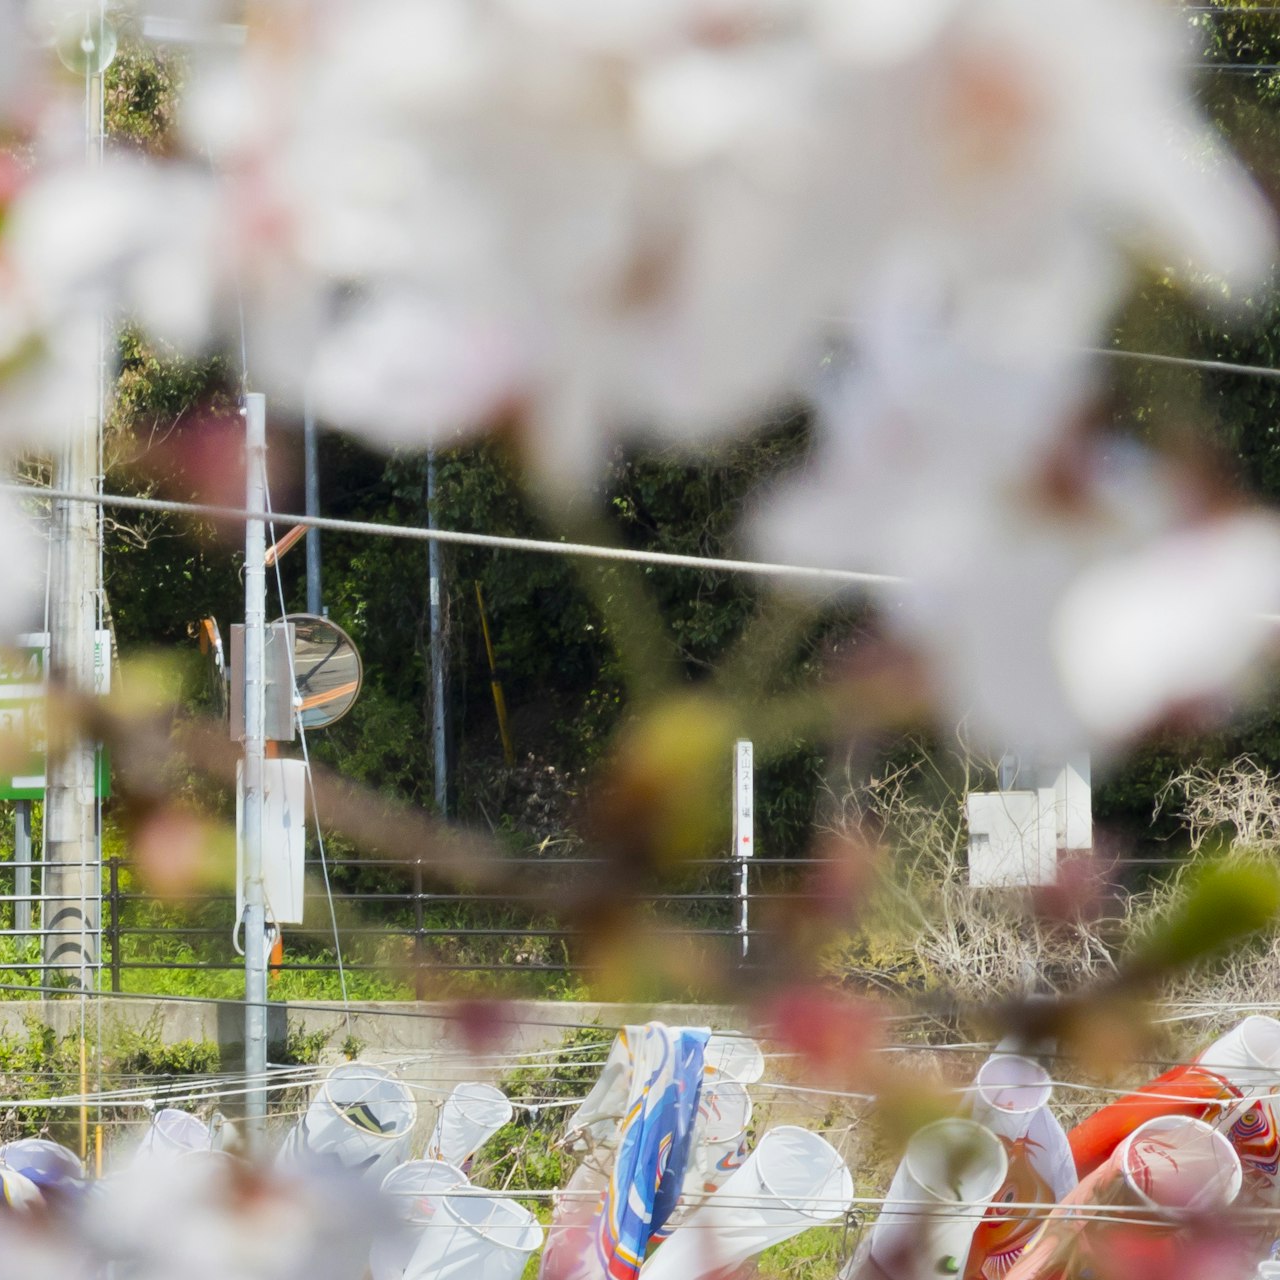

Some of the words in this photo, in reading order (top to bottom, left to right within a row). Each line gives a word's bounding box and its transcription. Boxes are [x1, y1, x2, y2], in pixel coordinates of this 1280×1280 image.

[741, 745, 751, 818] 天山スキー場
